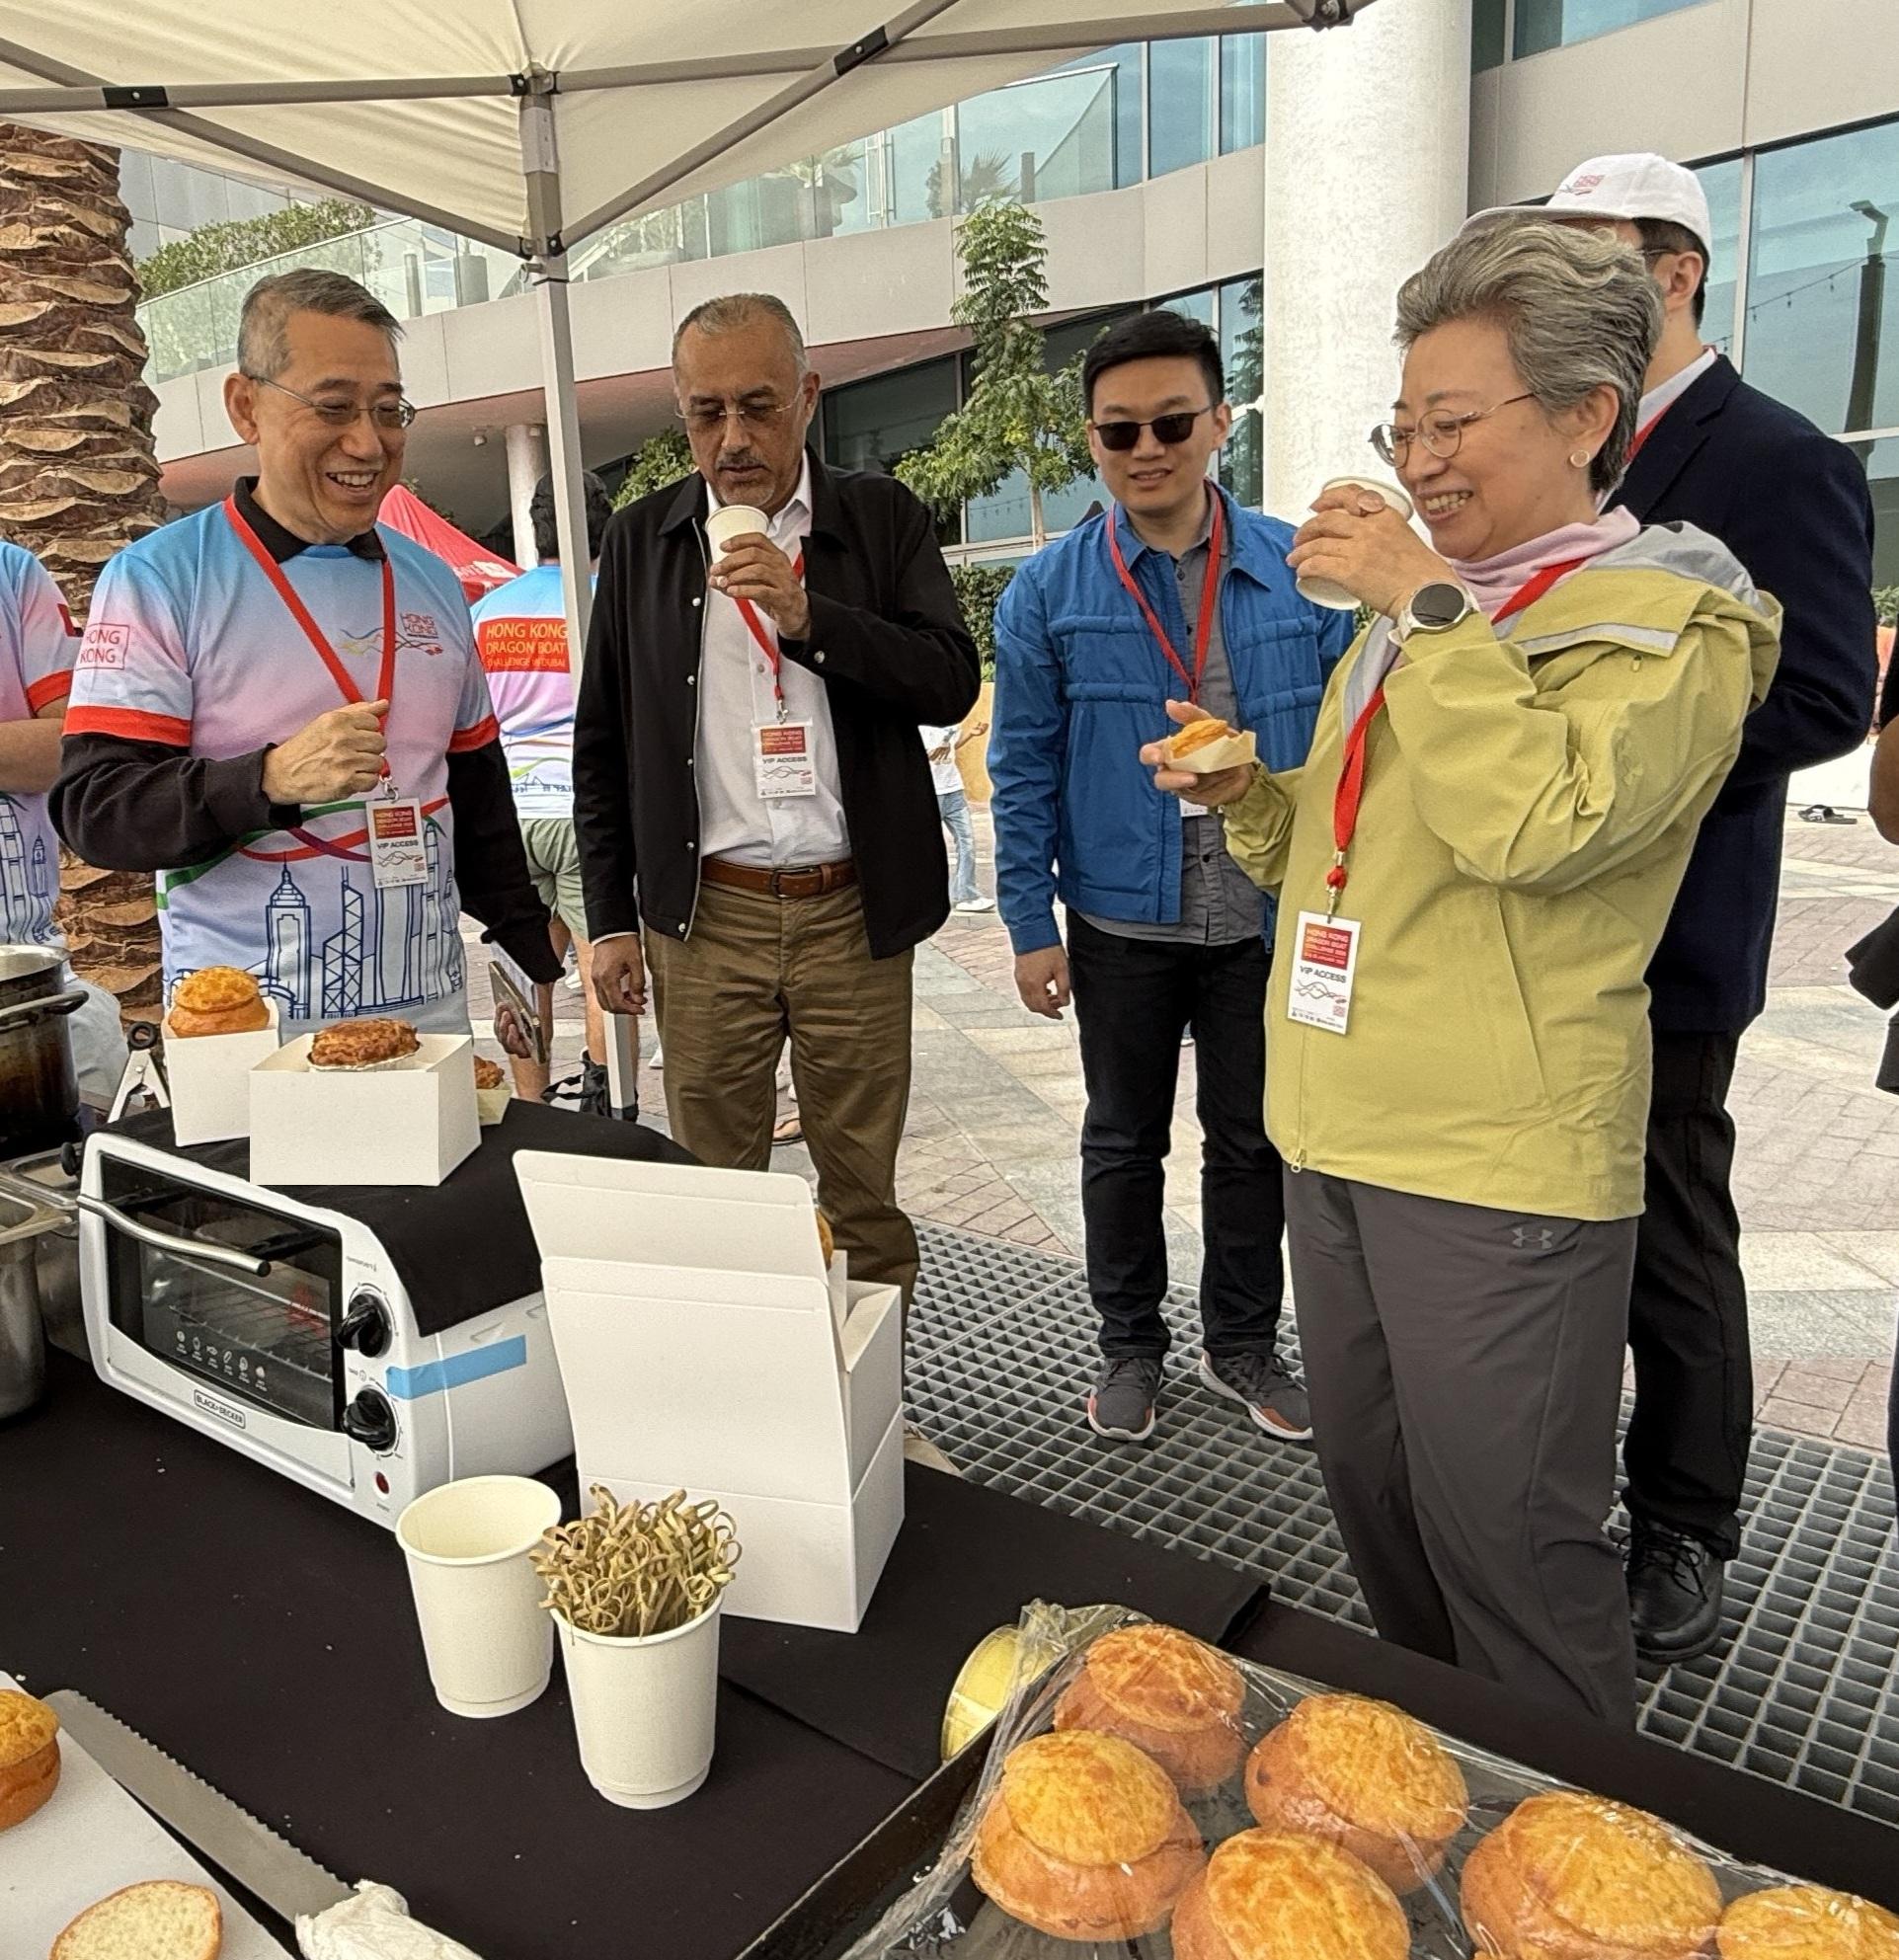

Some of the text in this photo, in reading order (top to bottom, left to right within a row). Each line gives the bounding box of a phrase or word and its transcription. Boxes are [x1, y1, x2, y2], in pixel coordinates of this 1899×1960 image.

[486, 622, 569, 639] HONG KONG
[79, 647, 116, 664] KONG
[485, 640, 566, 655] DRAGON BOAT
[390, 839, 419, 848] ACCESS
[1300, 965, 1347, 983] VIP ACCESS
